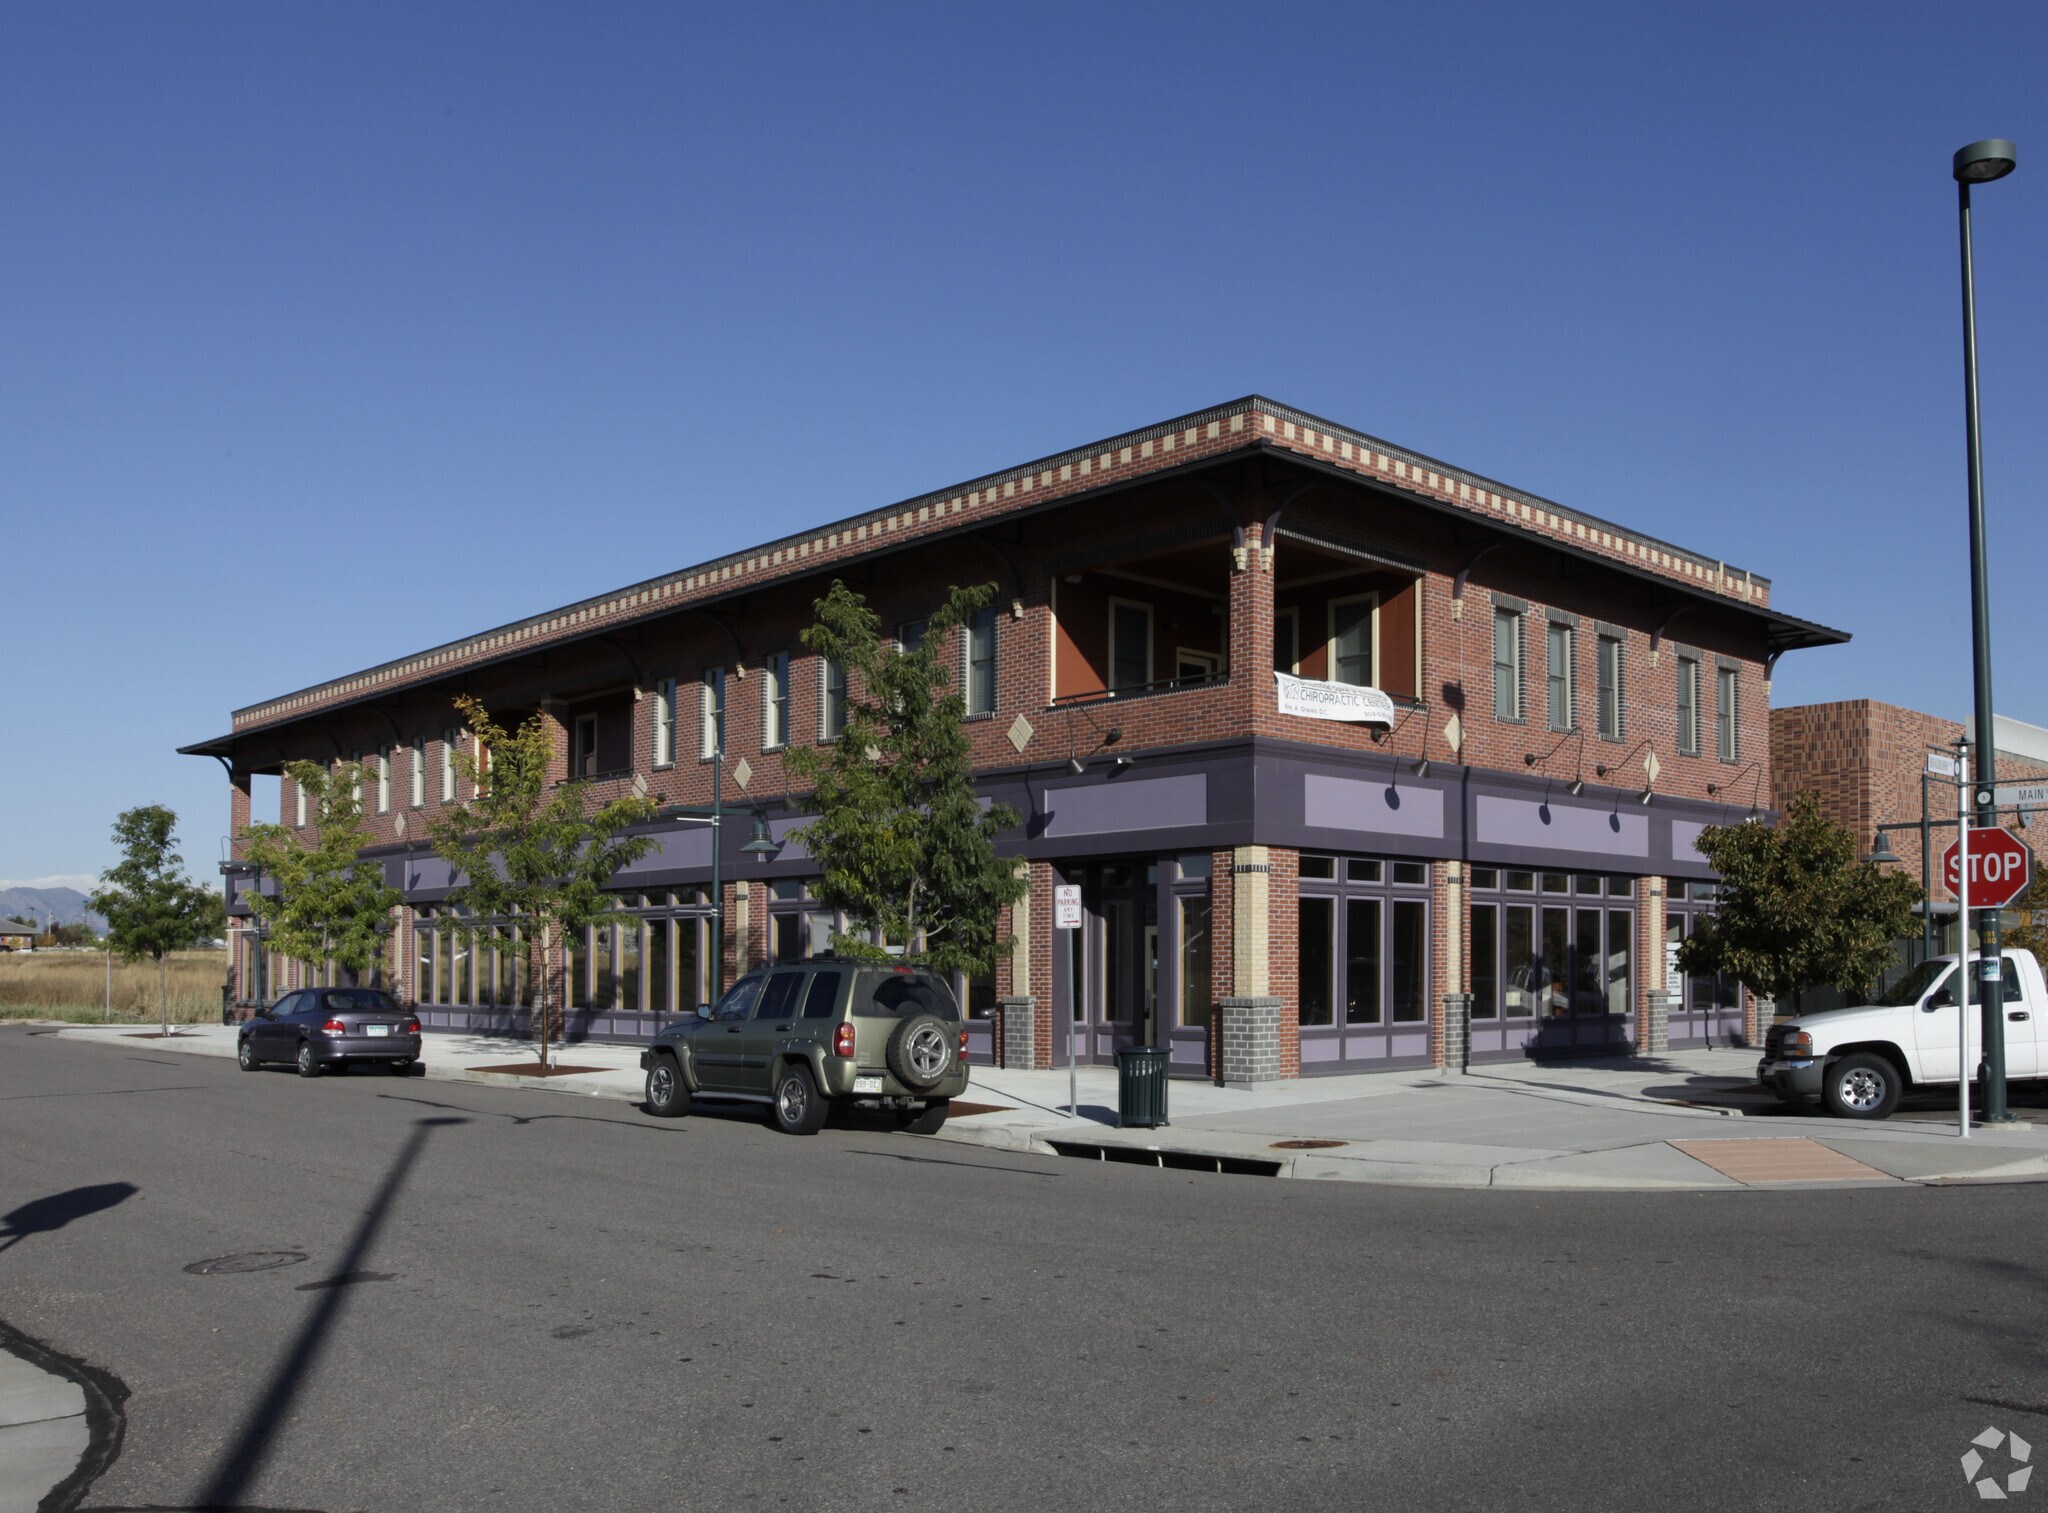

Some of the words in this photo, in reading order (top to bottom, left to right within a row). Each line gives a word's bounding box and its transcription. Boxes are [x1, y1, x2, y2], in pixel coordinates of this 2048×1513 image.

[1300, 689, 1360, 707] CHIROPRACTIC
[1362, 697, 1392, 711] CENTER
[1301, 706, 1318, 714] Graves
[2018, 788, 2044, 801] MAIN
[1948, 852, 2021, 884] STOP
[1063, 889, 1073, 897] NO
[1057, 898, 1079, 906] PARKING
